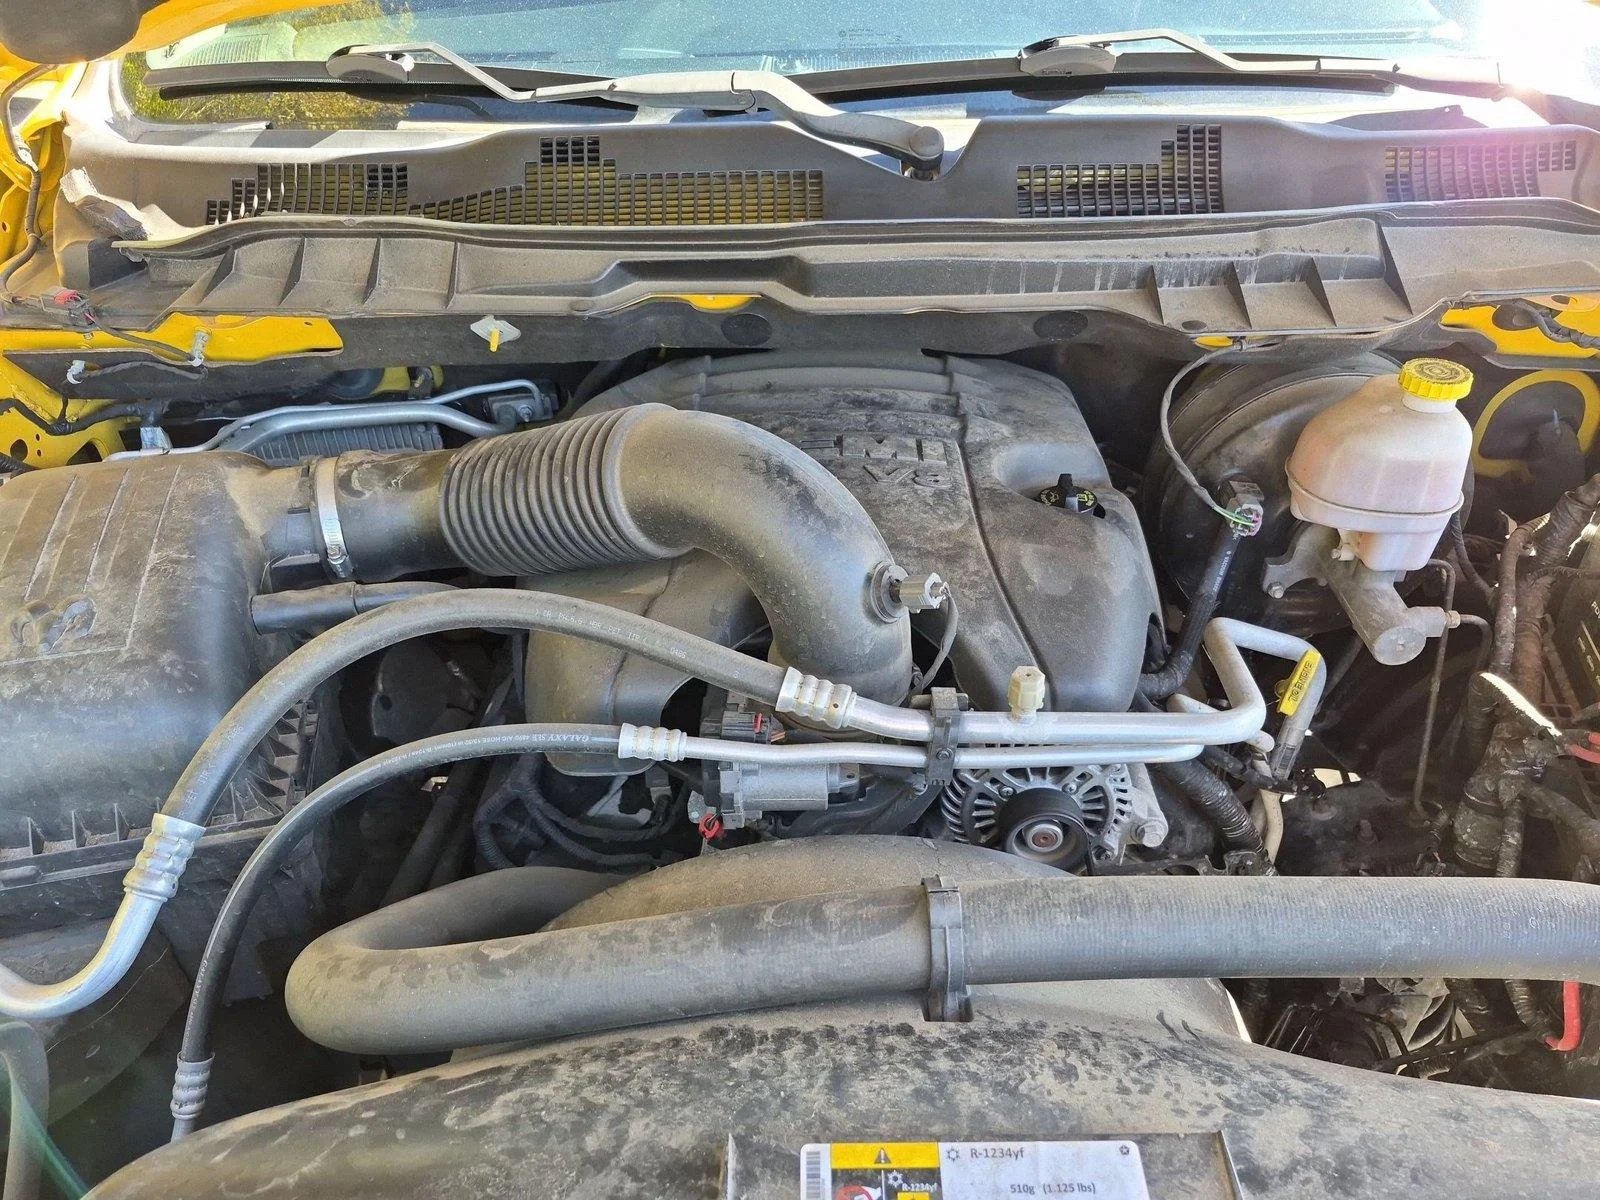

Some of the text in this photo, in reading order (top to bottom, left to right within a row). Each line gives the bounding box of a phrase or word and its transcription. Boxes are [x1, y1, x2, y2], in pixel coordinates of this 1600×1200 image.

[481, 735, 500, 744] HOSE
[547, 733, 590, 743] GALAXY
[970, 1147, 1025, 1160] R-1234yf
[902, 1182, 938, 1193] R-1234yf
[1010, 1182, 1096, 1195] 510g (1.125 lbs)
